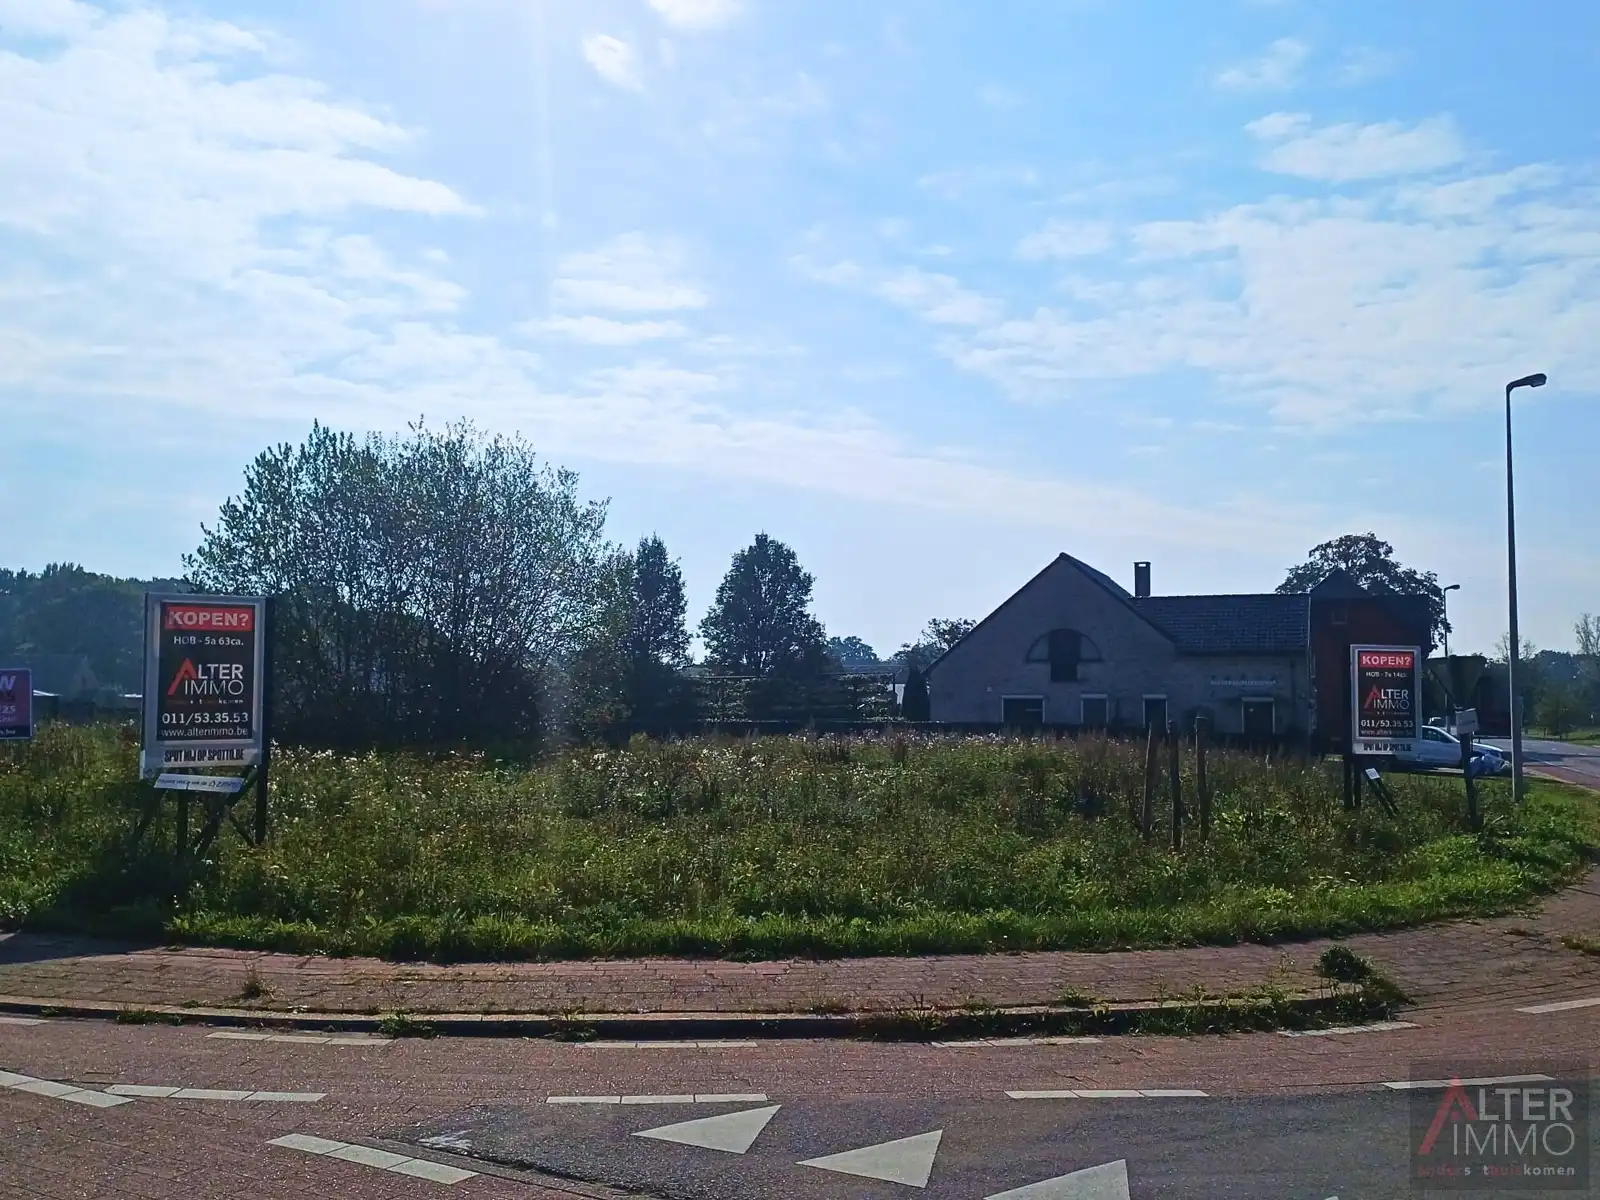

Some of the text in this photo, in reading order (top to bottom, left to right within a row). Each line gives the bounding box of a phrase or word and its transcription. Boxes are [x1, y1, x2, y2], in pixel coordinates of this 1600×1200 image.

[168, 611, 249, 627] KOPEN?
[173, 636, 196, 645] HOB
[204, 637, 217, 646] 5a
[218, 637, 244, 646] 63ca.
[1362, 655, 1411, 666] KOPEN?
[167, 658, 244, 695] ALTER
[184, 679, 244, 695] IMMO
[1363, 684, 1409, 709] ALTER
[1373, 699, 1410, 710] IMMO
[162, 712, 249, 726] 011/53.35.53
[161, 726, 248, 738] www.alterimmo.be
